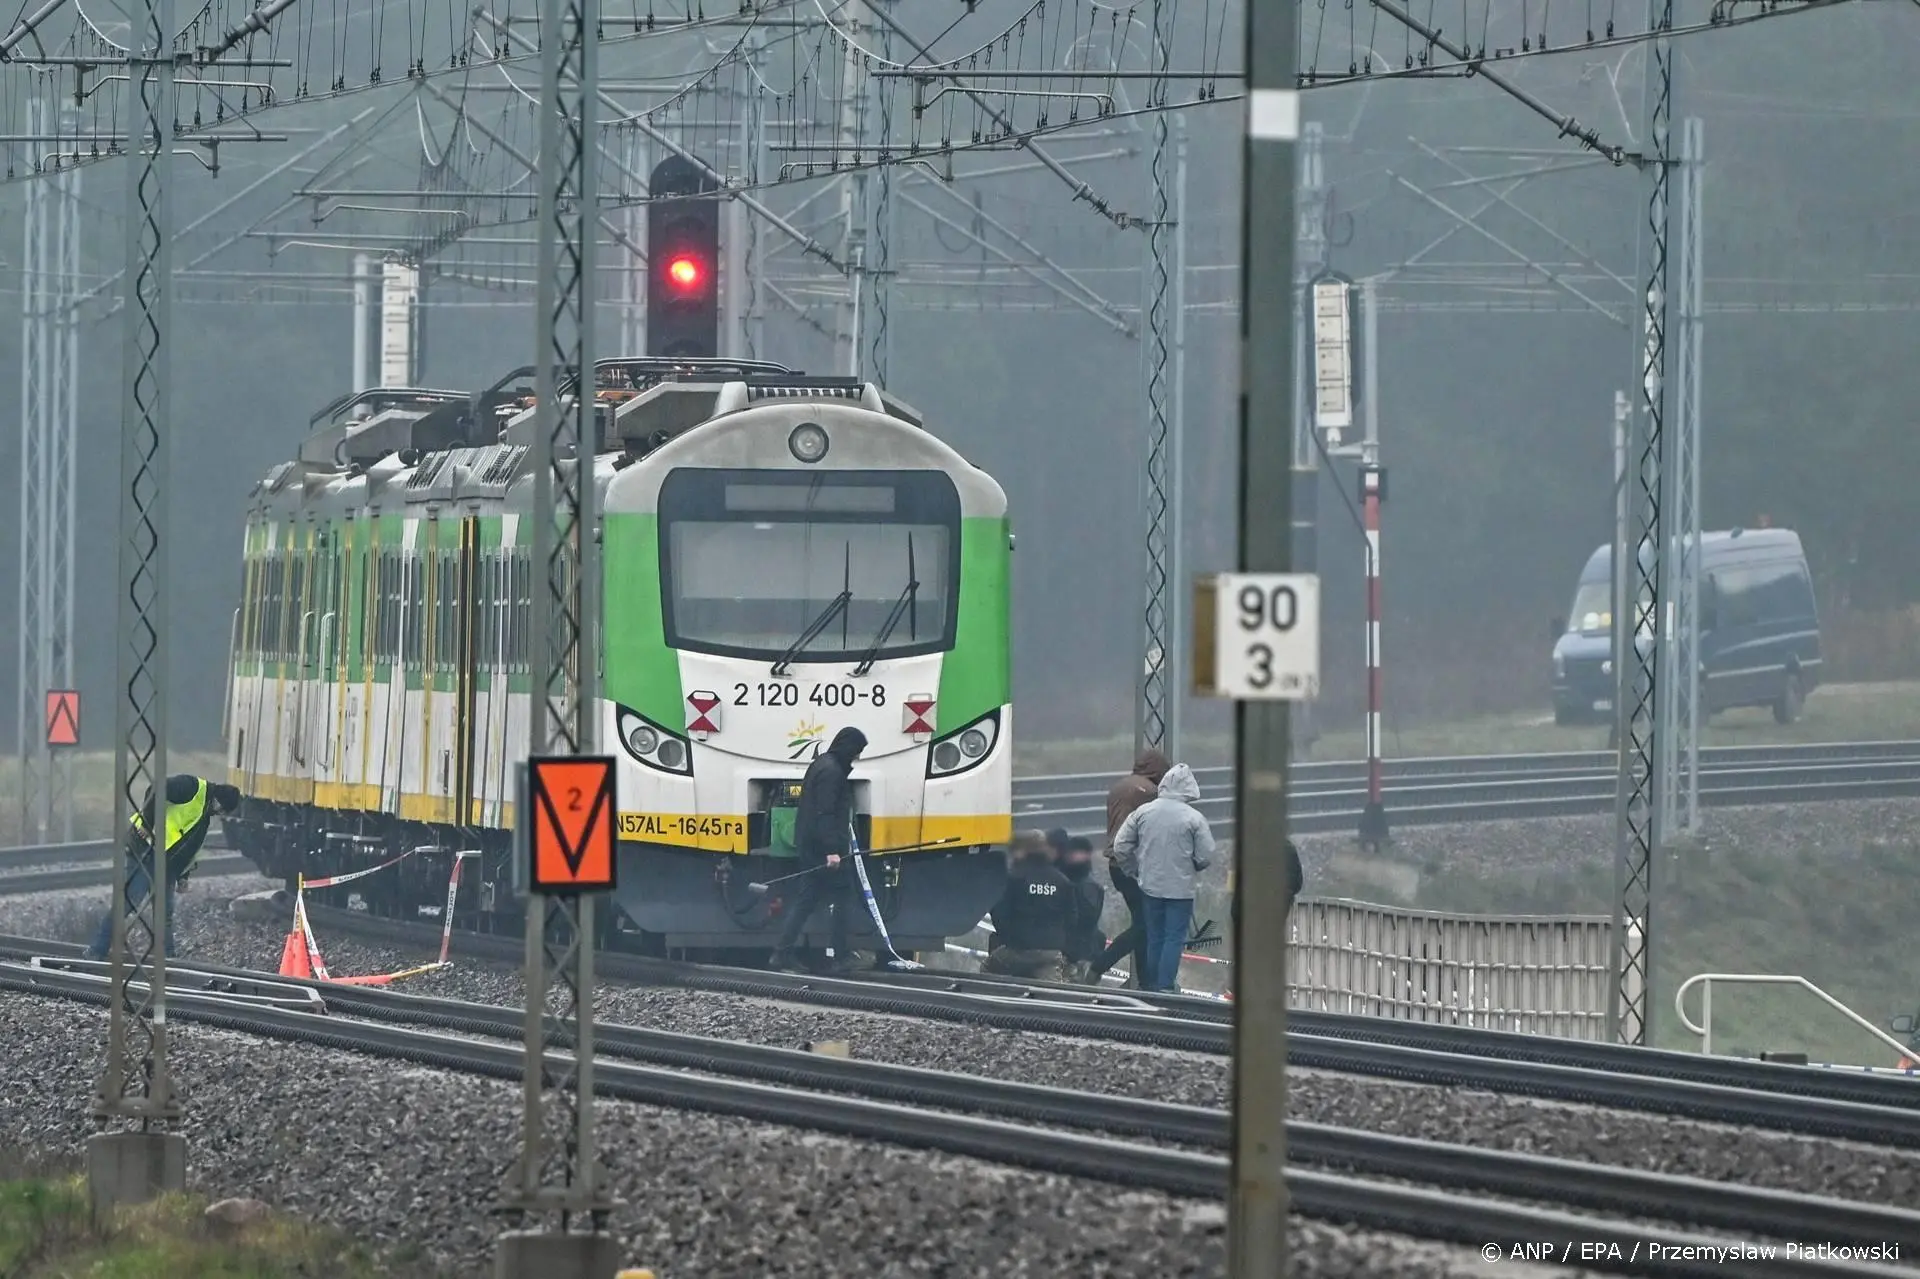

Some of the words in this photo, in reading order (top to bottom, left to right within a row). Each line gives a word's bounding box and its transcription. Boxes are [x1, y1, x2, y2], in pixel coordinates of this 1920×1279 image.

[1238, 584, 1297, 632] 90
[1246, 642, 1275, 689] 3
[733, 682, 749, 706] 2
[757, 683, 799, 706] 120
[808, 683, 886, 707] 400-8
[567, 786, 583, 812] 2
[1029, 882, 1057, 896] CBŚP
